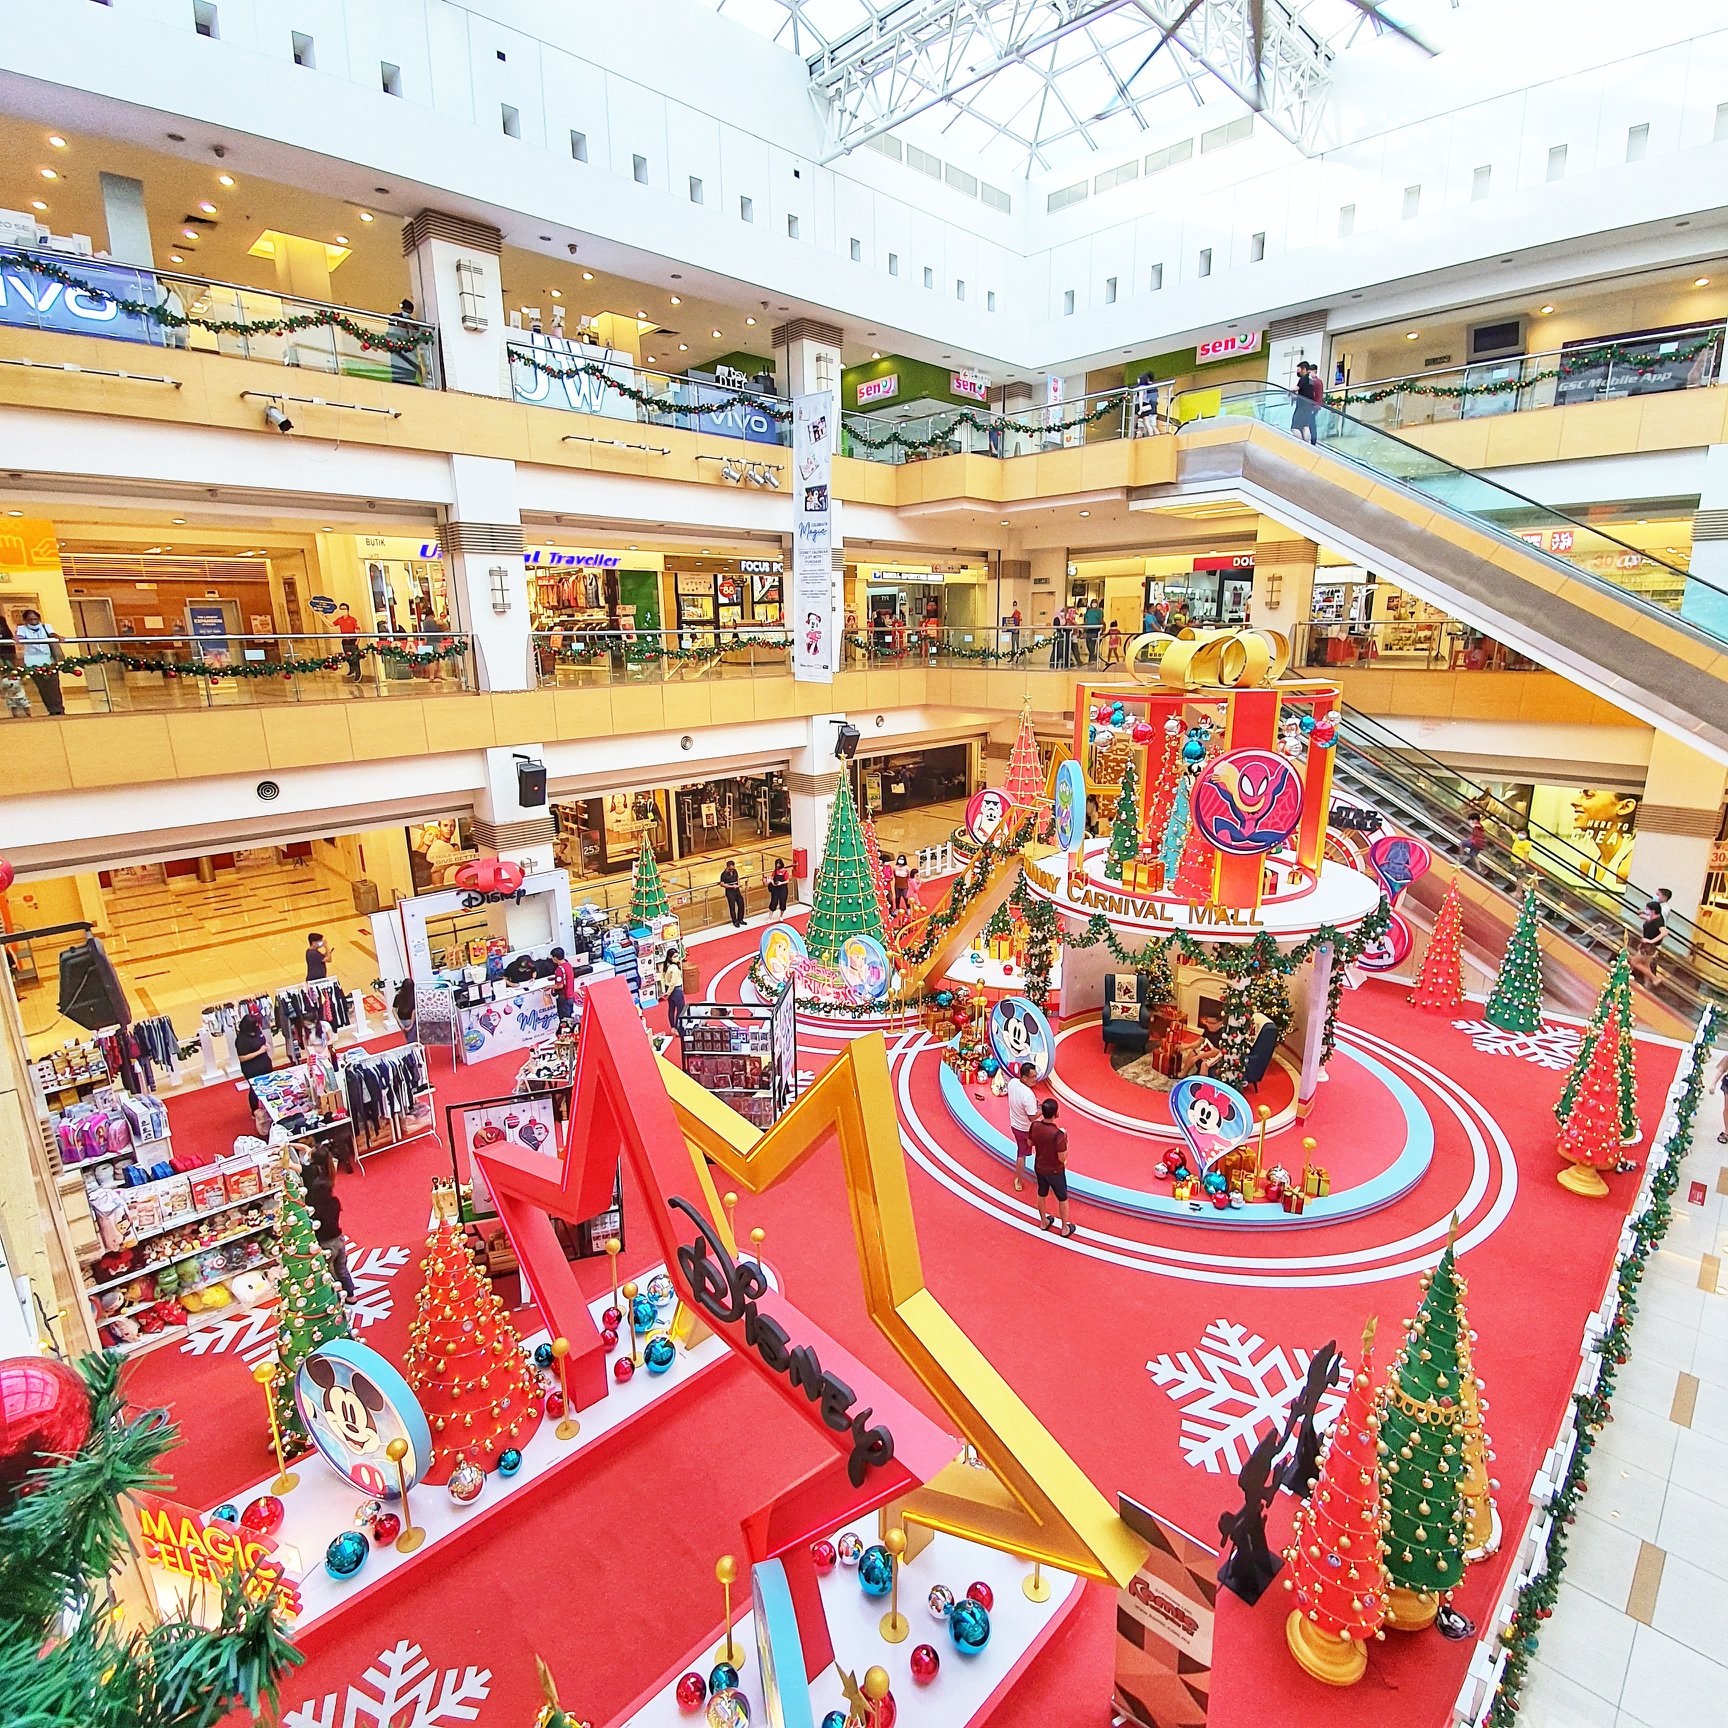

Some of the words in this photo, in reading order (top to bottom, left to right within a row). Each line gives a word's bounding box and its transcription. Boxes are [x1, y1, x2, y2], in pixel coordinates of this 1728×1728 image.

[1200, 332, 1255, 356] senQ
[858, 377, 893, 399] senQ
[1558, 380, 1587, 392] GSC
[1588, 374, 1638, 388] Mobile
[1640, 371, 1673, 383] App
[365, 537, 386, 547] BUTIK
[549, 551, 622, 567] Traveller
[741, 560, 770, 572] FOCUS
[1587, 819, 1613, 830] HERE
[1616, 822, 1630, 831] TO
[456, 888, 526, 909] Disney
[1067, 879, 1173, 921] CARNIVAL
[1188, 897, 1264, 926] MALL
[668, 1196, 894, 1489] Disney
[140, 1508, 280, 1580] MAGIC
